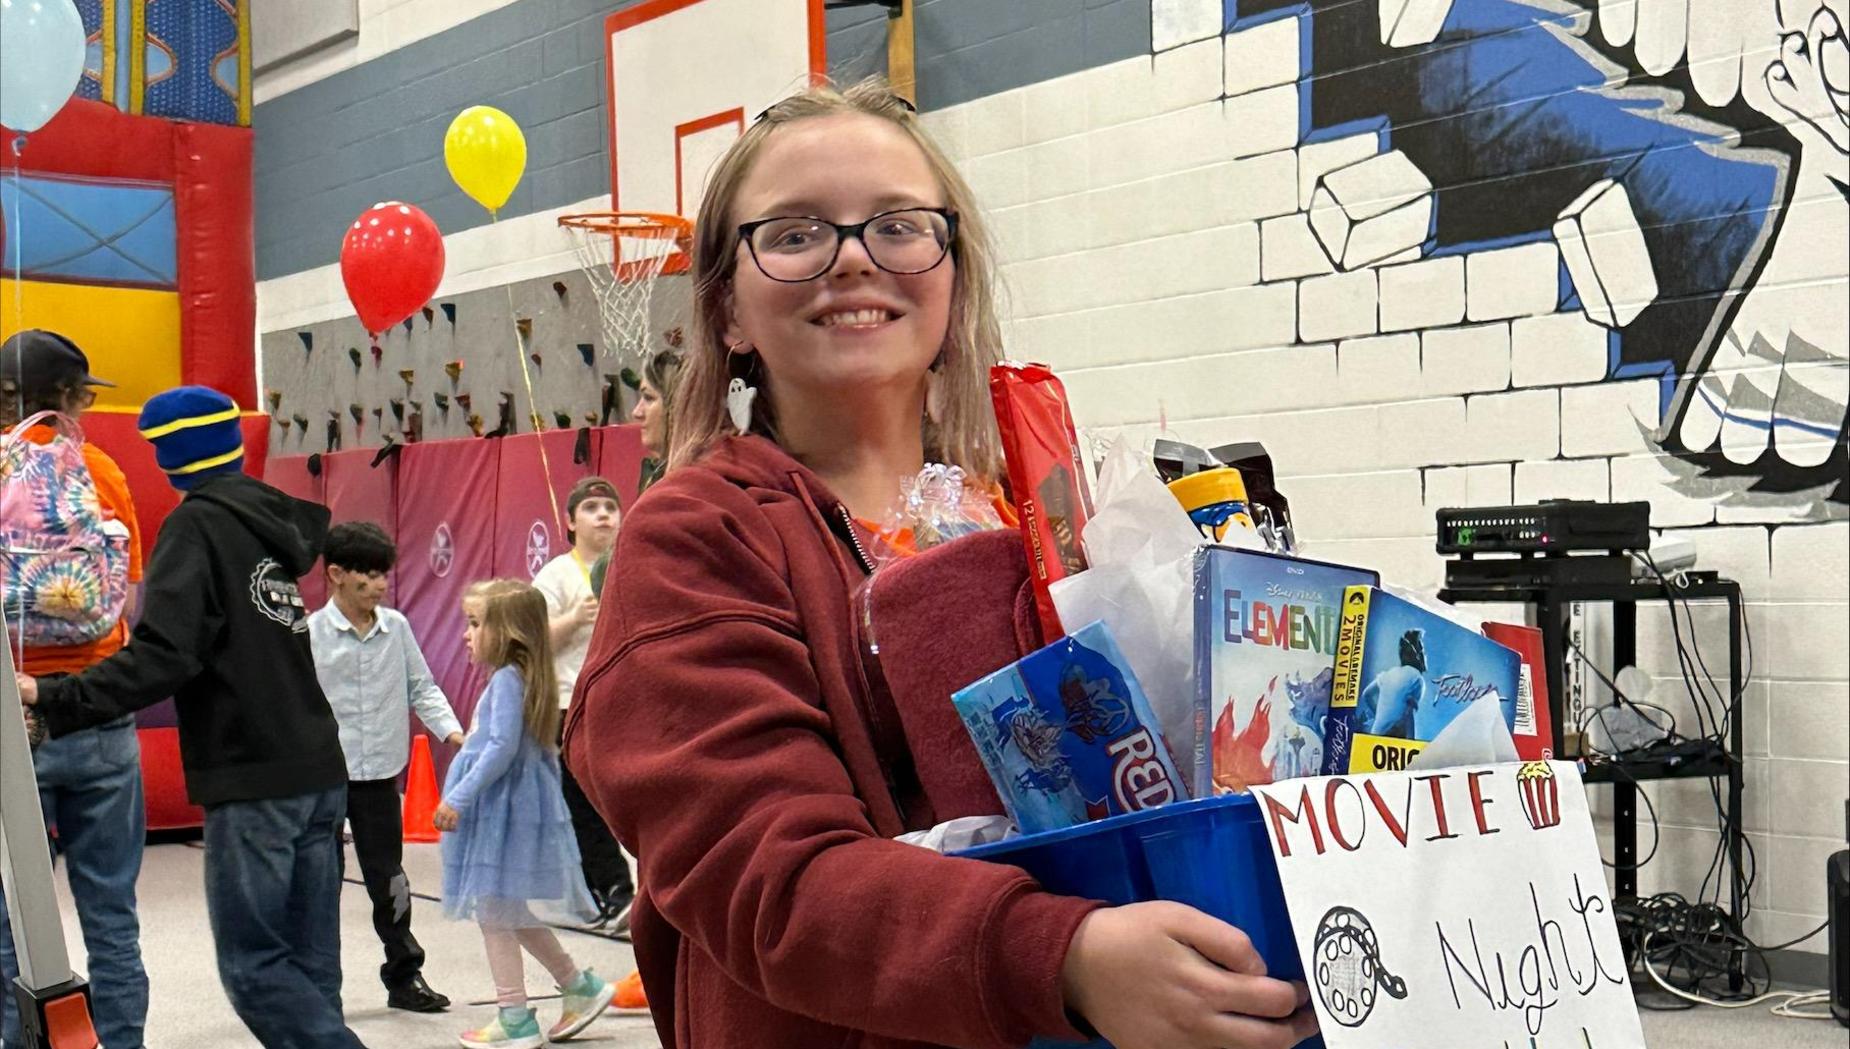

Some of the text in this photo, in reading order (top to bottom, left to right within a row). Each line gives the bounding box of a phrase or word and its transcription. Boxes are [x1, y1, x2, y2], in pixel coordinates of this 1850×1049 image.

[1224, 589, 1337, 656] ELEMENT
[1335, 628, 1353, 702] MOVIES
[1106, 726, 1177, 812] RED
[1261, 771, 1500, 857] MOVIE
[1436, 873, 1623, 1035] Night
